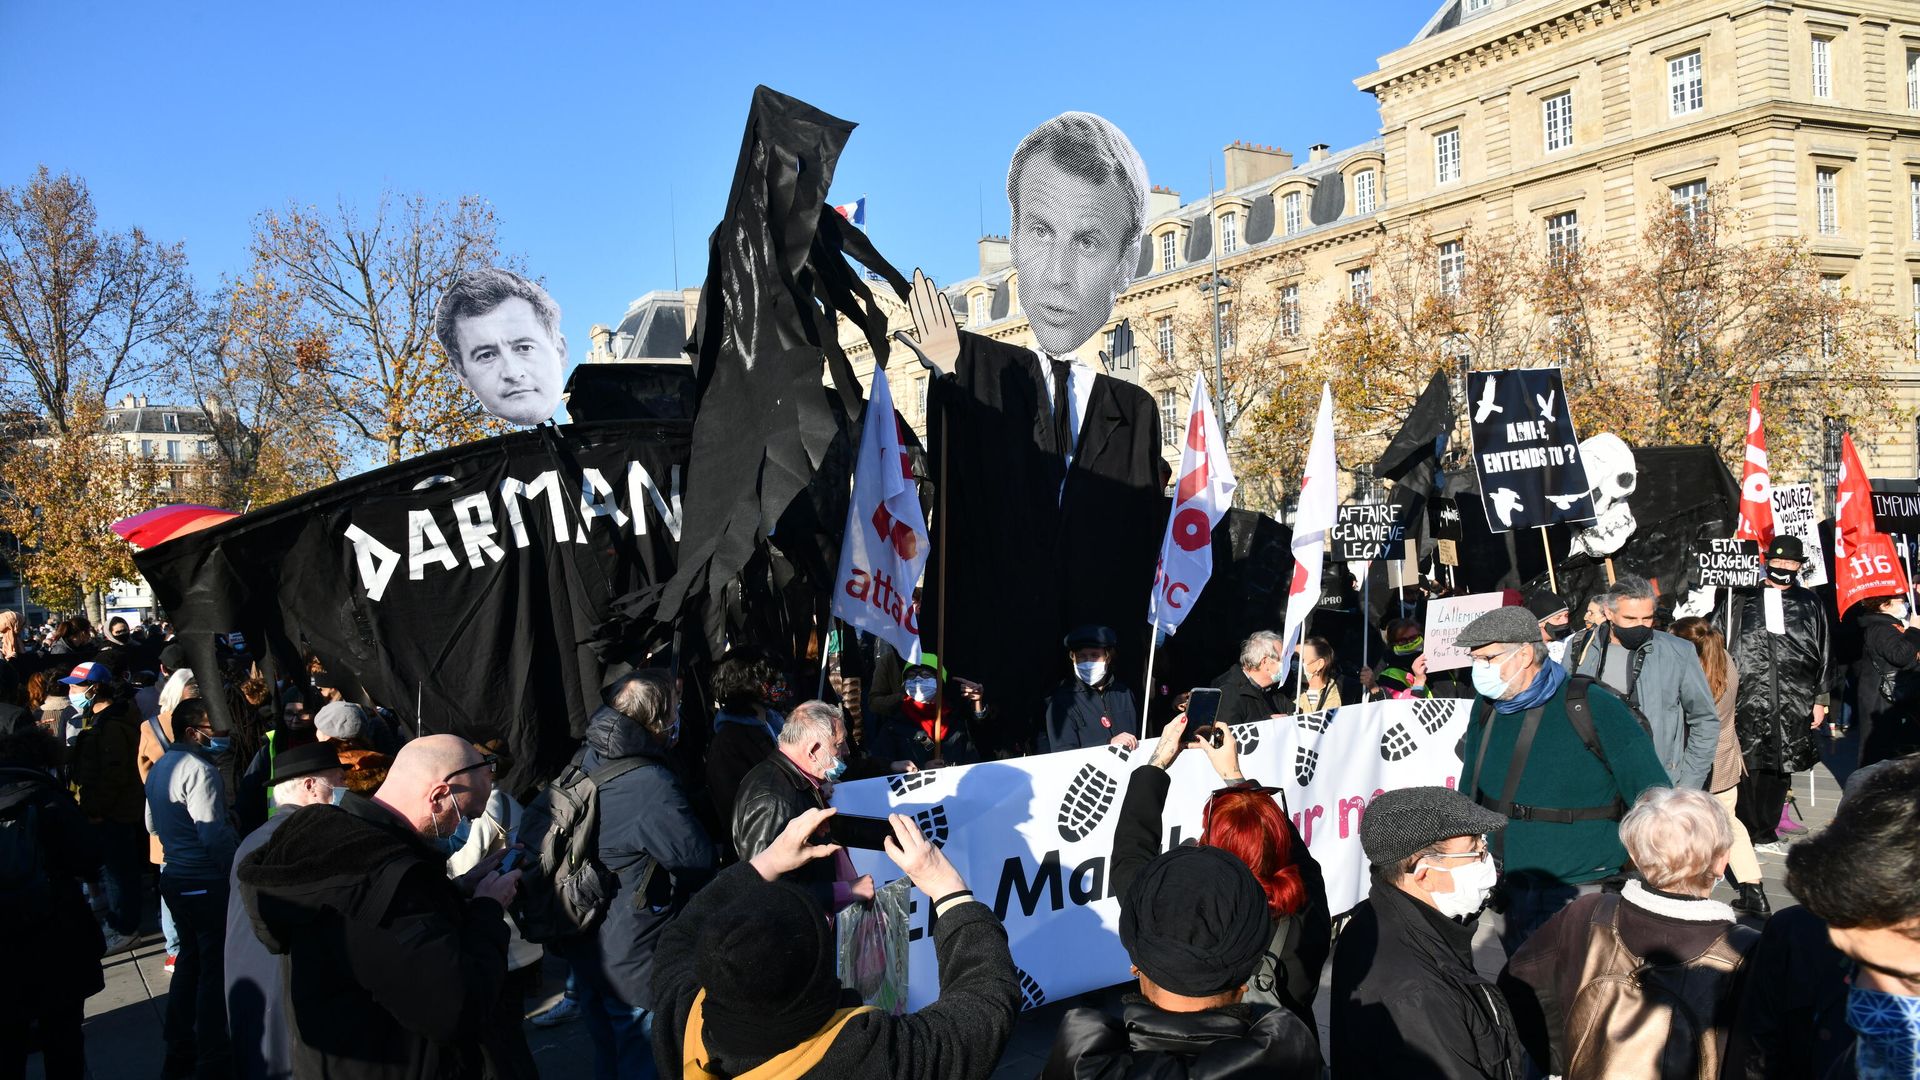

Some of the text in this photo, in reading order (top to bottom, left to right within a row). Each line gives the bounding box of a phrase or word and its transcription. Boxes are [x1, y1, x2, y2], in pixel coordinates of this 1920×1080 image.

[1483, 446, 1547, 474] ENTENDS
[1548, 446, 1564, 466] TU
[1339, 504, 1402, 523] AFFAIRE
[1780, 511, 1797, 524] VOUS
[1331, 522, 1405, 541] GENEVIÈVE
[1344, 542, 1391, 560] LEGAY
[1710, 539, 1745, 554] ETAT
[1700, 569, 1760, 587] PERMANENT
